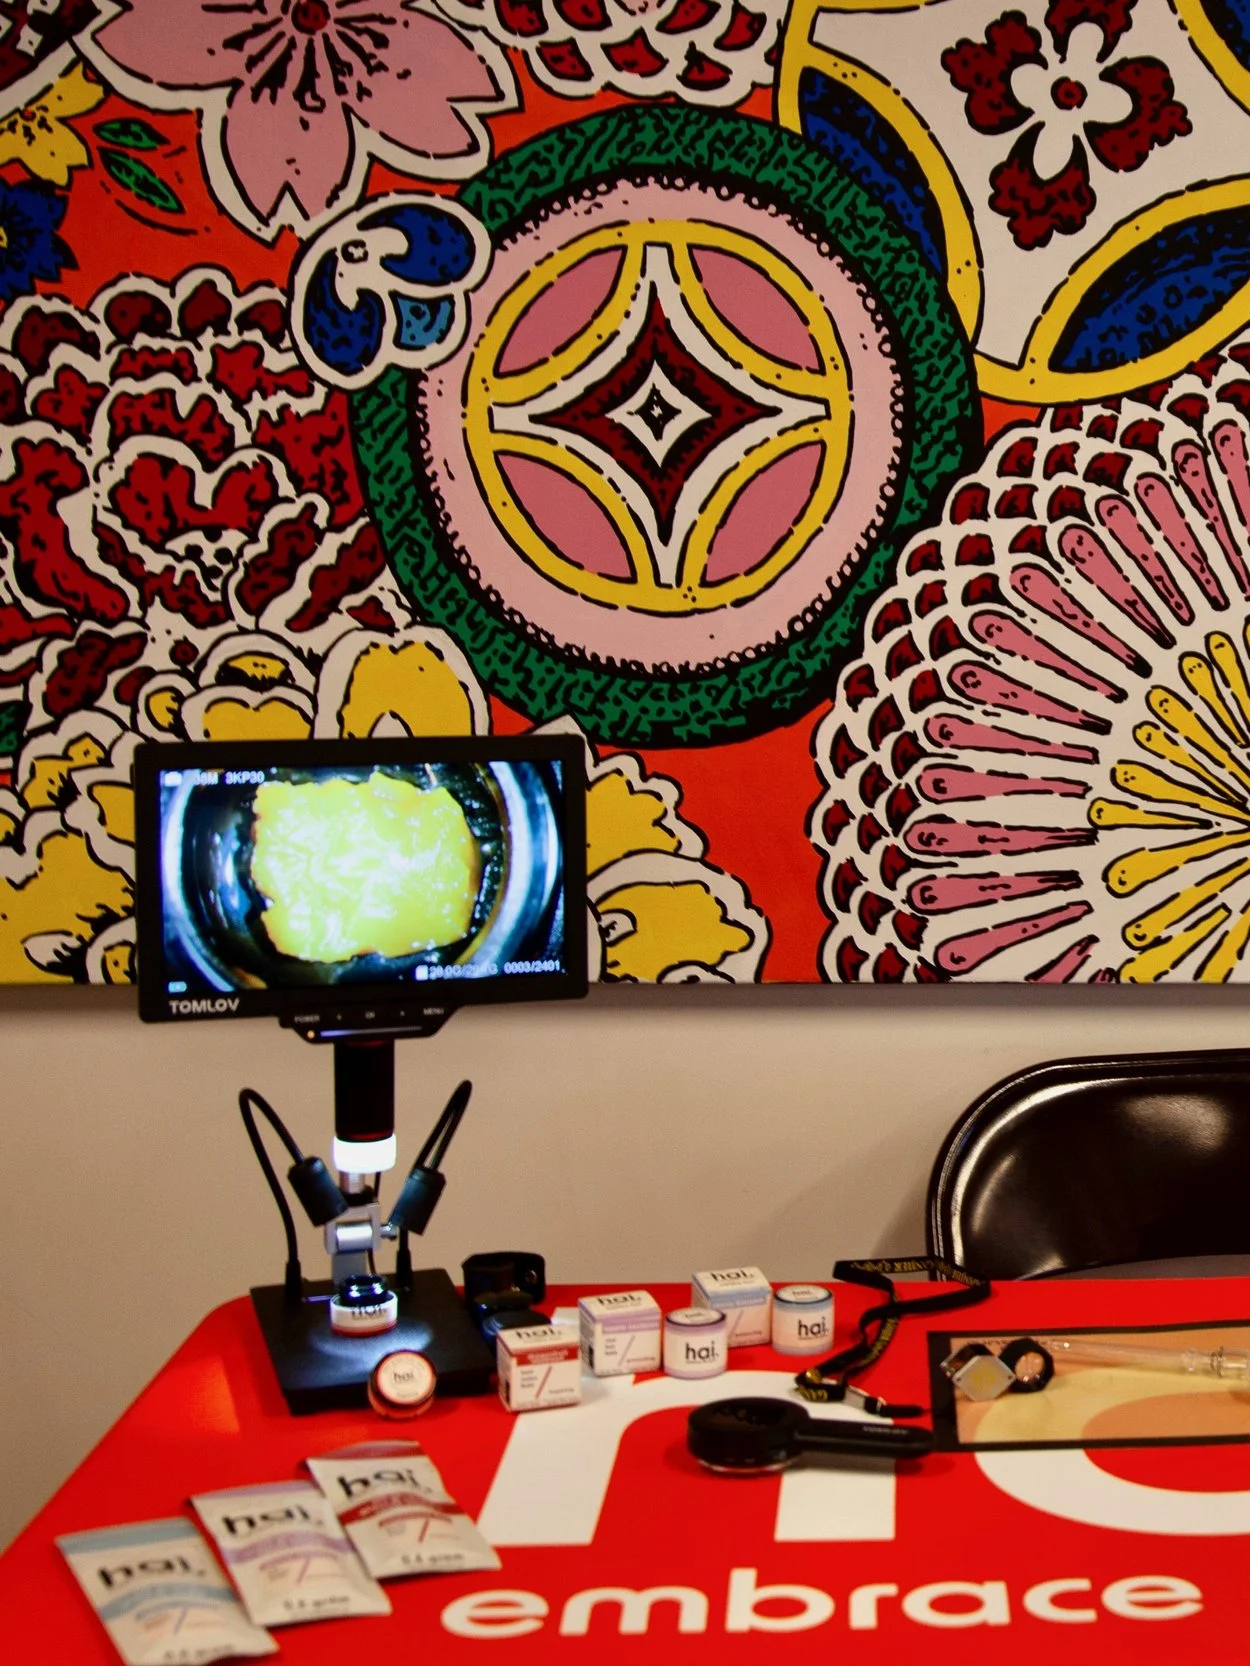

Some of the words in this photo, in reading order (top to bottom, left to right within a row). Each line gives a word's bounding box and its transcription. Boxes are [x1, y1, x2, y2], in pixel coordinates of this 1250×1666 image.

[169, 998, 240, 1014] TOMLOV
[710, 1269, 754, 1281] hai.
[597, 1294, 642, 1306] hai.
[515, 1327, 562, 1340] hai.
[797, 1316, 830, 1336] hai.
[684, 1340, 719, 1361] hai.
[337, 1468, 433, 1499] hai.
[220, 1504, 325, 1537] hai.
[97, 1556, 206, 1588] hai.
[441, 1568, 1203, 1639] embrace
